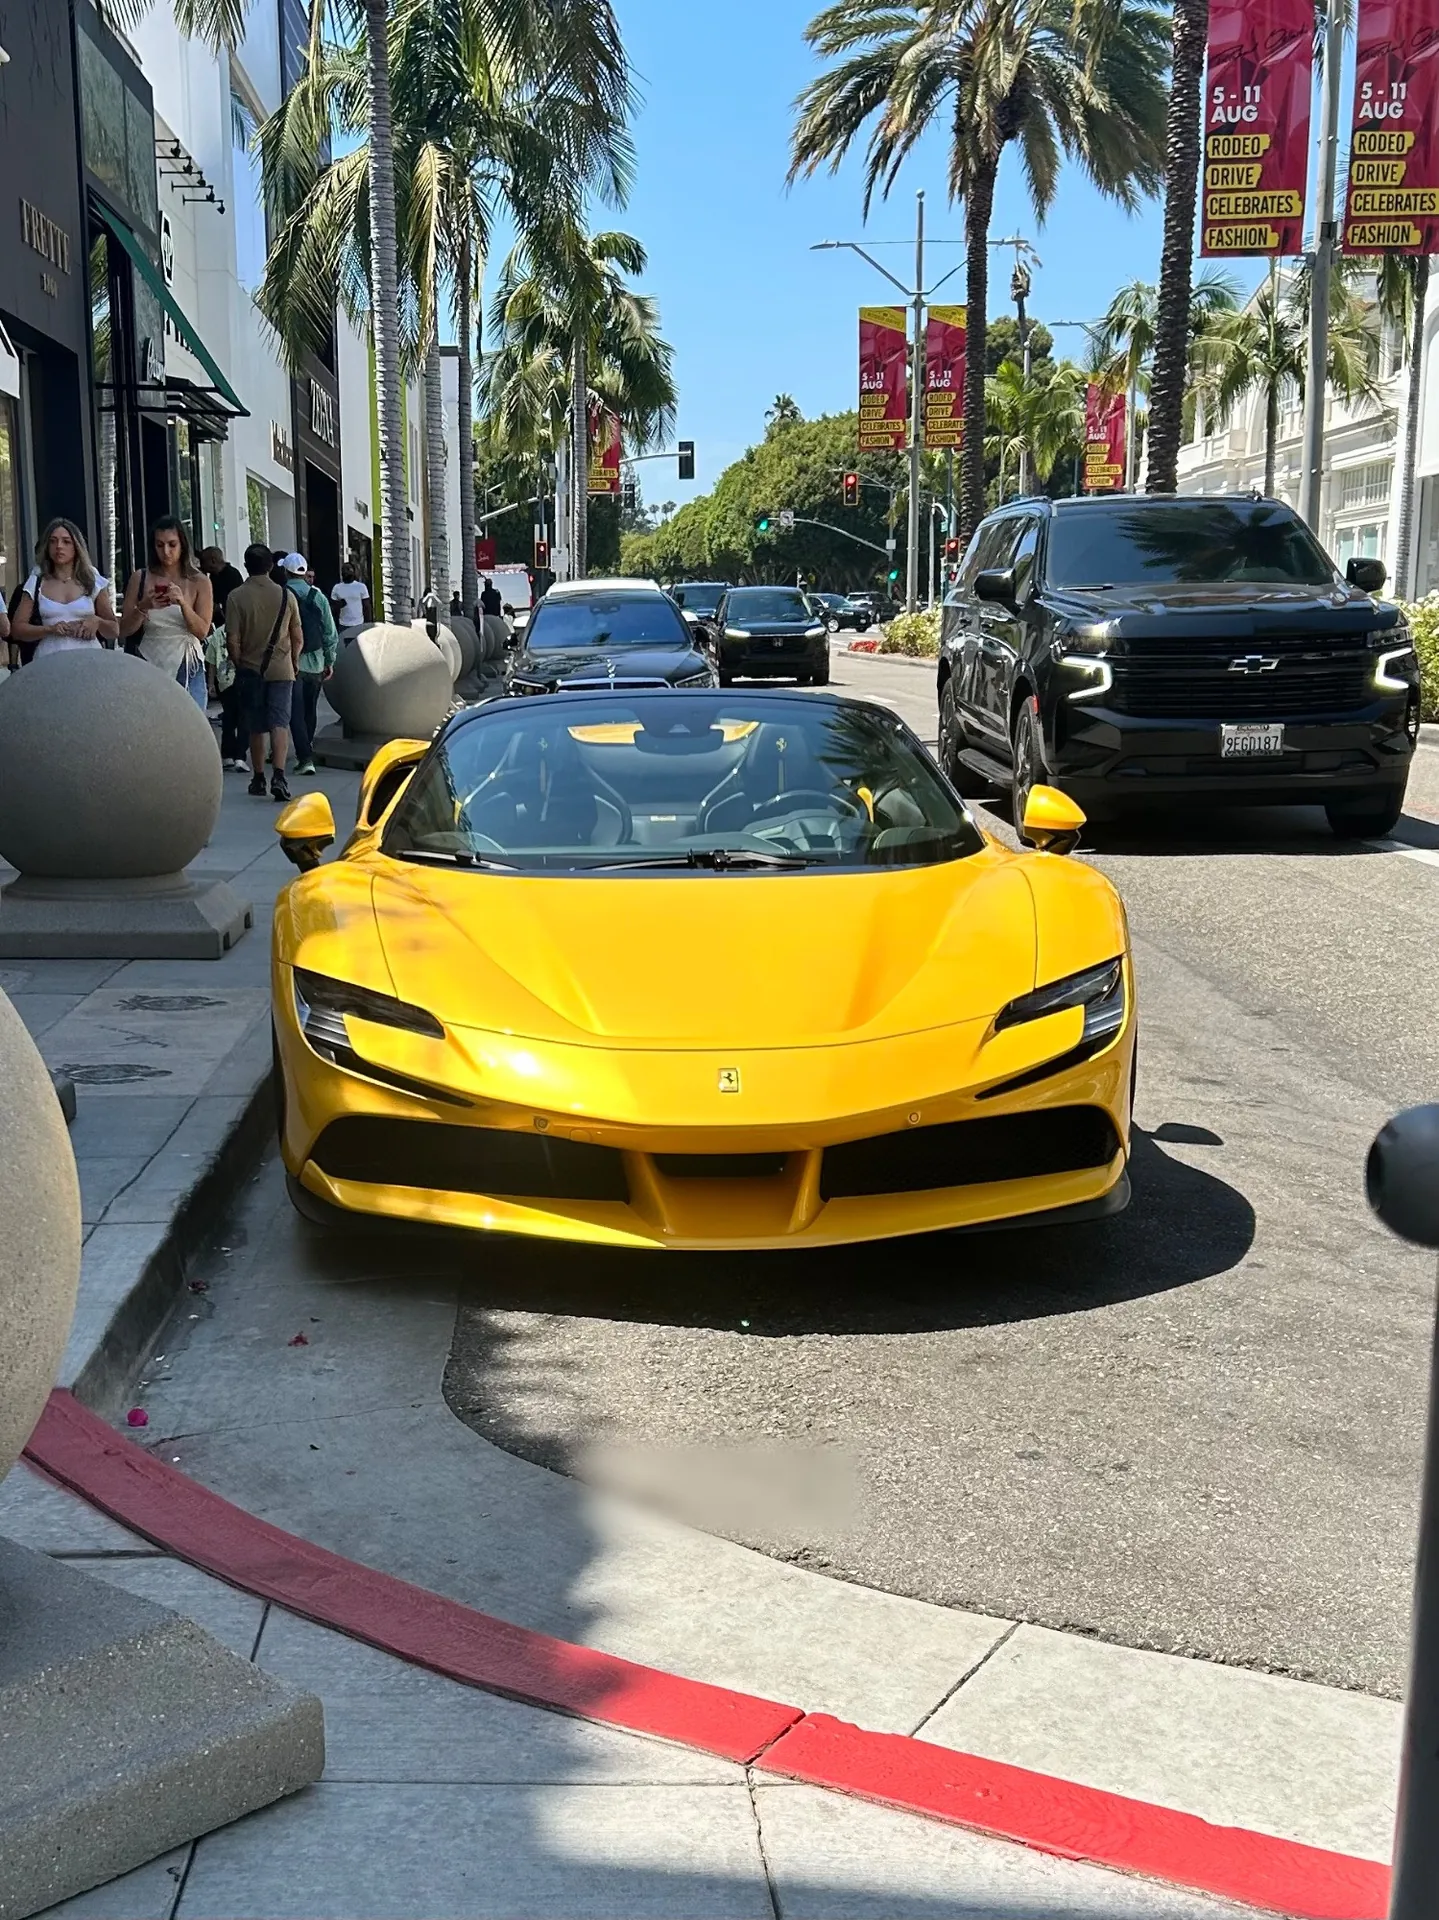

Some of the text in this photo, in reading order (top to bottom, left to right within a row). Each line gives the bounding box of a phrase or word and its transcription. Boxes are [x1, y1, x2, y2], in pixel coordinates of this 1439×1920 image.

[1212, 86, 1225, 104] 5
[1243, 85, 1261, 104] 11
[1361, 82, 1373, 100] 5
[1391, 82, 1407, 100] 11
[1210, 104, 1259, 123] AUG
[1358, 101, 1405, 119] AUG
[1211, 136, 1260, 156] RODEO
[1358, 133, 1405, 152] RODEO
[1210, 166, 1255, 186] DRIVE
[1356, 163, 1399, 182] DRIVE
[1209, 195, 1293, 215] CELEBRATES
[1353, 193, 1437, 212] CELEBRATES
[21, 198, 71, 275] FRETTE
[1208, 227, 1268, 247] FASHION
[1350, 224, 1411, 244] FASHION
[862, 372, 869, 381] 5
[875, 372, 884, 381] 11
[928, 379, 951, 388] AUG
[929, 370, 936, 379] 5
[943, 370, 952, 379] 11
[861, 380, 883, 389] AUG
[862, 395, 886, 405] RODEO
[928, 393, 953, 403] RODEO
[861, 408, 883, 418] DRIVE
[928, 406, 949, 416] DRIVE
[861, 421, 902, 431] CELEBRATES
[861, 435, 890, 445] FASHION
[928, 434, 956, 444] FASHION
[1226, 735, 1279, 751] 9EGD187
